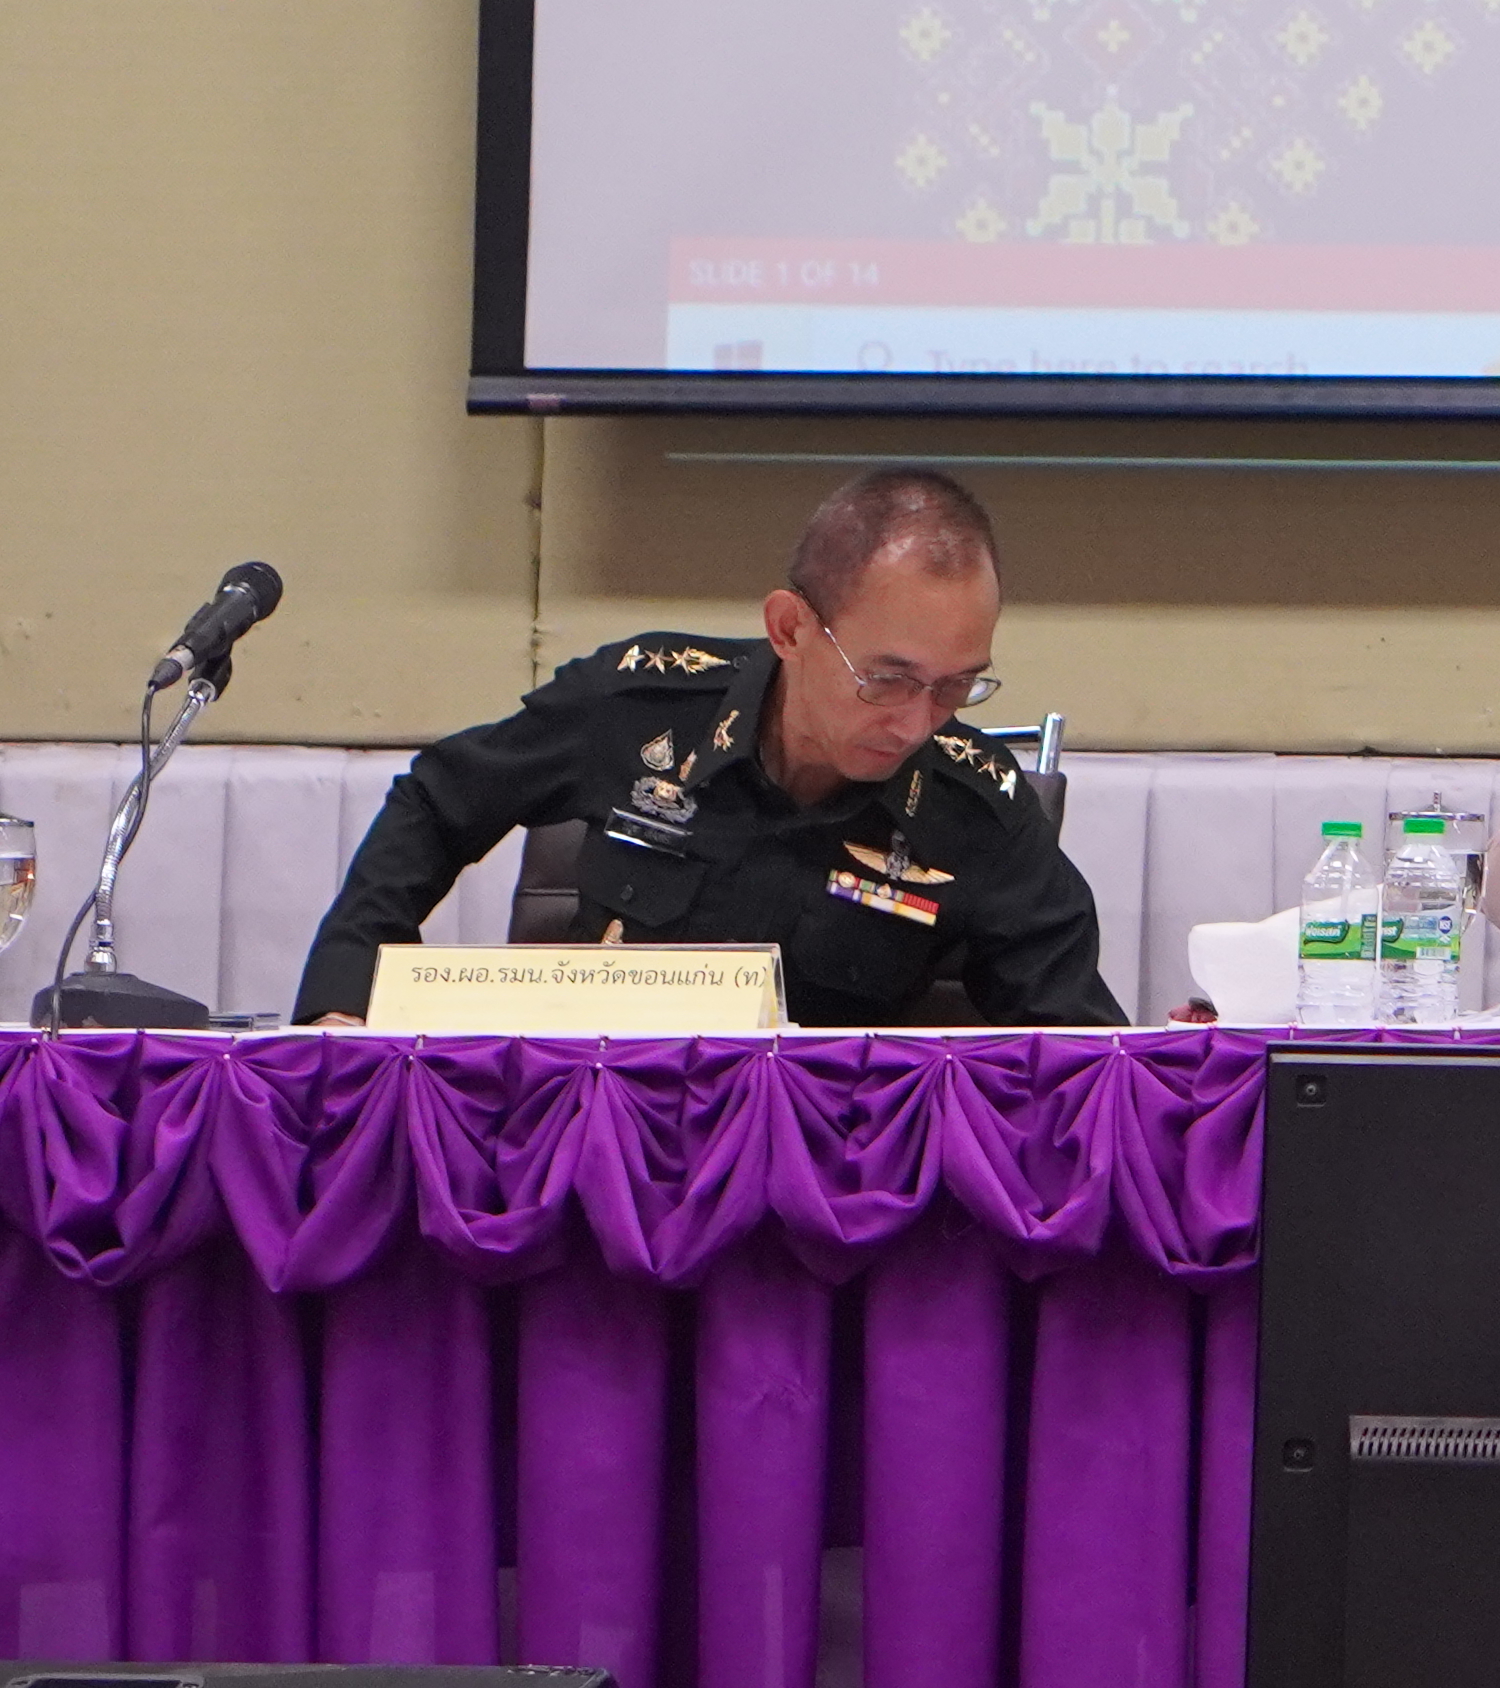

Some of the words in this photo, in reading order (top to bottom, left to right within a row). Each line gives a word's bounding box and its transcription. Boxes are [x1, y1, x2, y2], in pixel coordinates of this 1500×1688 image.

[689, 259, 764, 286] SLIDE
[850, 262, 880, 287] 14
[410, 959, 725, 986] รอง.ผอ.รมน.จังหวัดขอนแก่น
